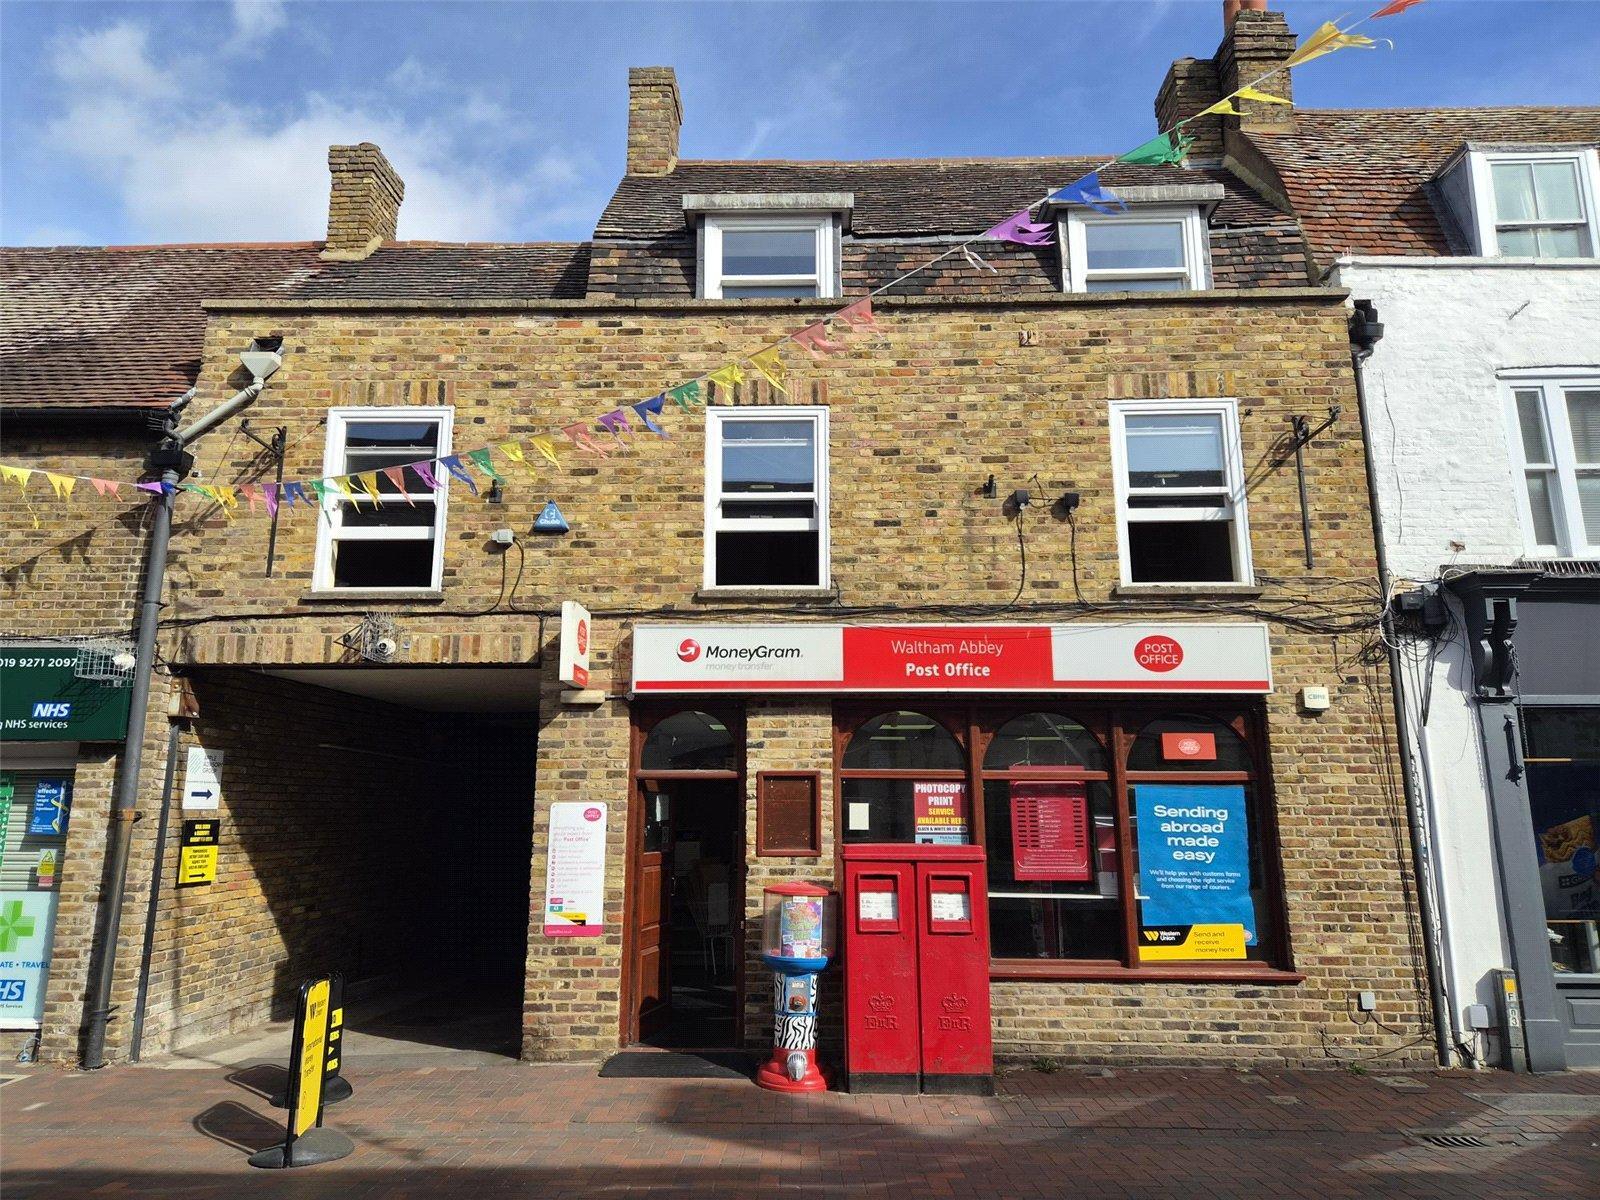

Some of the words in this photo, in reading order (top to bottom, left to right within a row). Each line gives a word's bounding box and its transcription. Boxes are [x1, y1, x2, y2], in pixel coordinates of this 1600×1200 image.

[891, 640, 955, 654] Waltham
[958, 639, 1004, 657] Abbey
[1144, 643, 1175, 653] POST
[19, 658, 45, 667] 9271
[47, 658, 78, 667] 2097
[1139, 654, 1179, 664] OFFICE
[705, 662, 737, 671] money
[737, 661, 774, 670] transfer
[905, 662, 940, 676] Post
[944, 662, 990, 676] Office
[34, 703, 71, 717] NHS
[5, 720, 27, 729] NHS
[28, 720, 68, 729] services
[915, 783, 966, 794] PHOTOCOPY
[928, 796, 954, 806] PRINT
[928, 807, 955, 816] SERVICE
[1153, 804, 1228, 821] Sending
[917, 816, 950, 825] AVAILABLE
[1160, 821, 1224, 834] abroad
[1167, 835, 1220, 847] made
[1172, 850, 1216, 864] easy
[22, 961, 50, 969] TRAVEL
